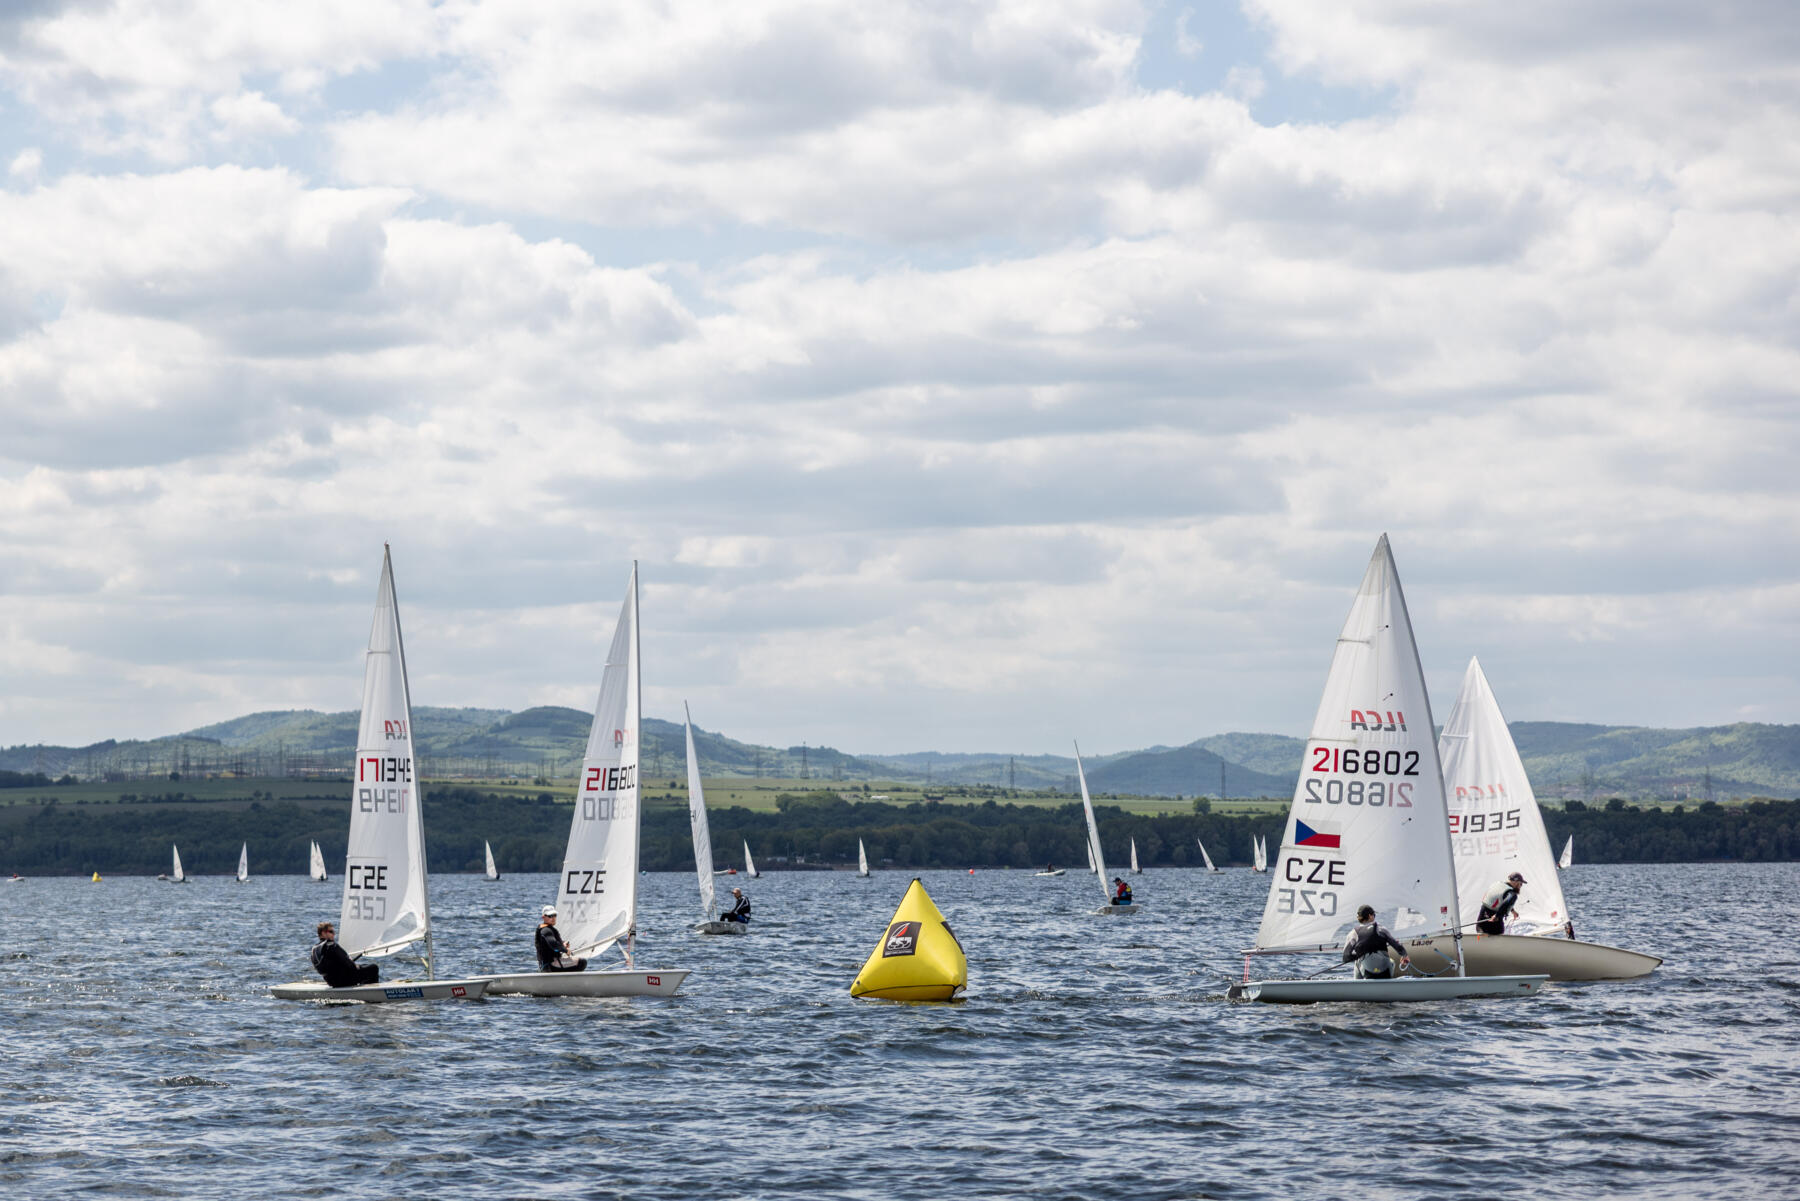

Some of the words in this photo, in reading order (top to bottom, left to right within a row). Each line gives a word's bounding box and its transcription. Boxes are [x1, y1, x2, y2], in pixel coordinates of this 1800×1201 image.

[1312, 746, 1420, 776] 216802
[350, 865, 388, 890] CZE
[566, 870, 607, 894] CZE
[1286, 857, 1346, 886] CZE
